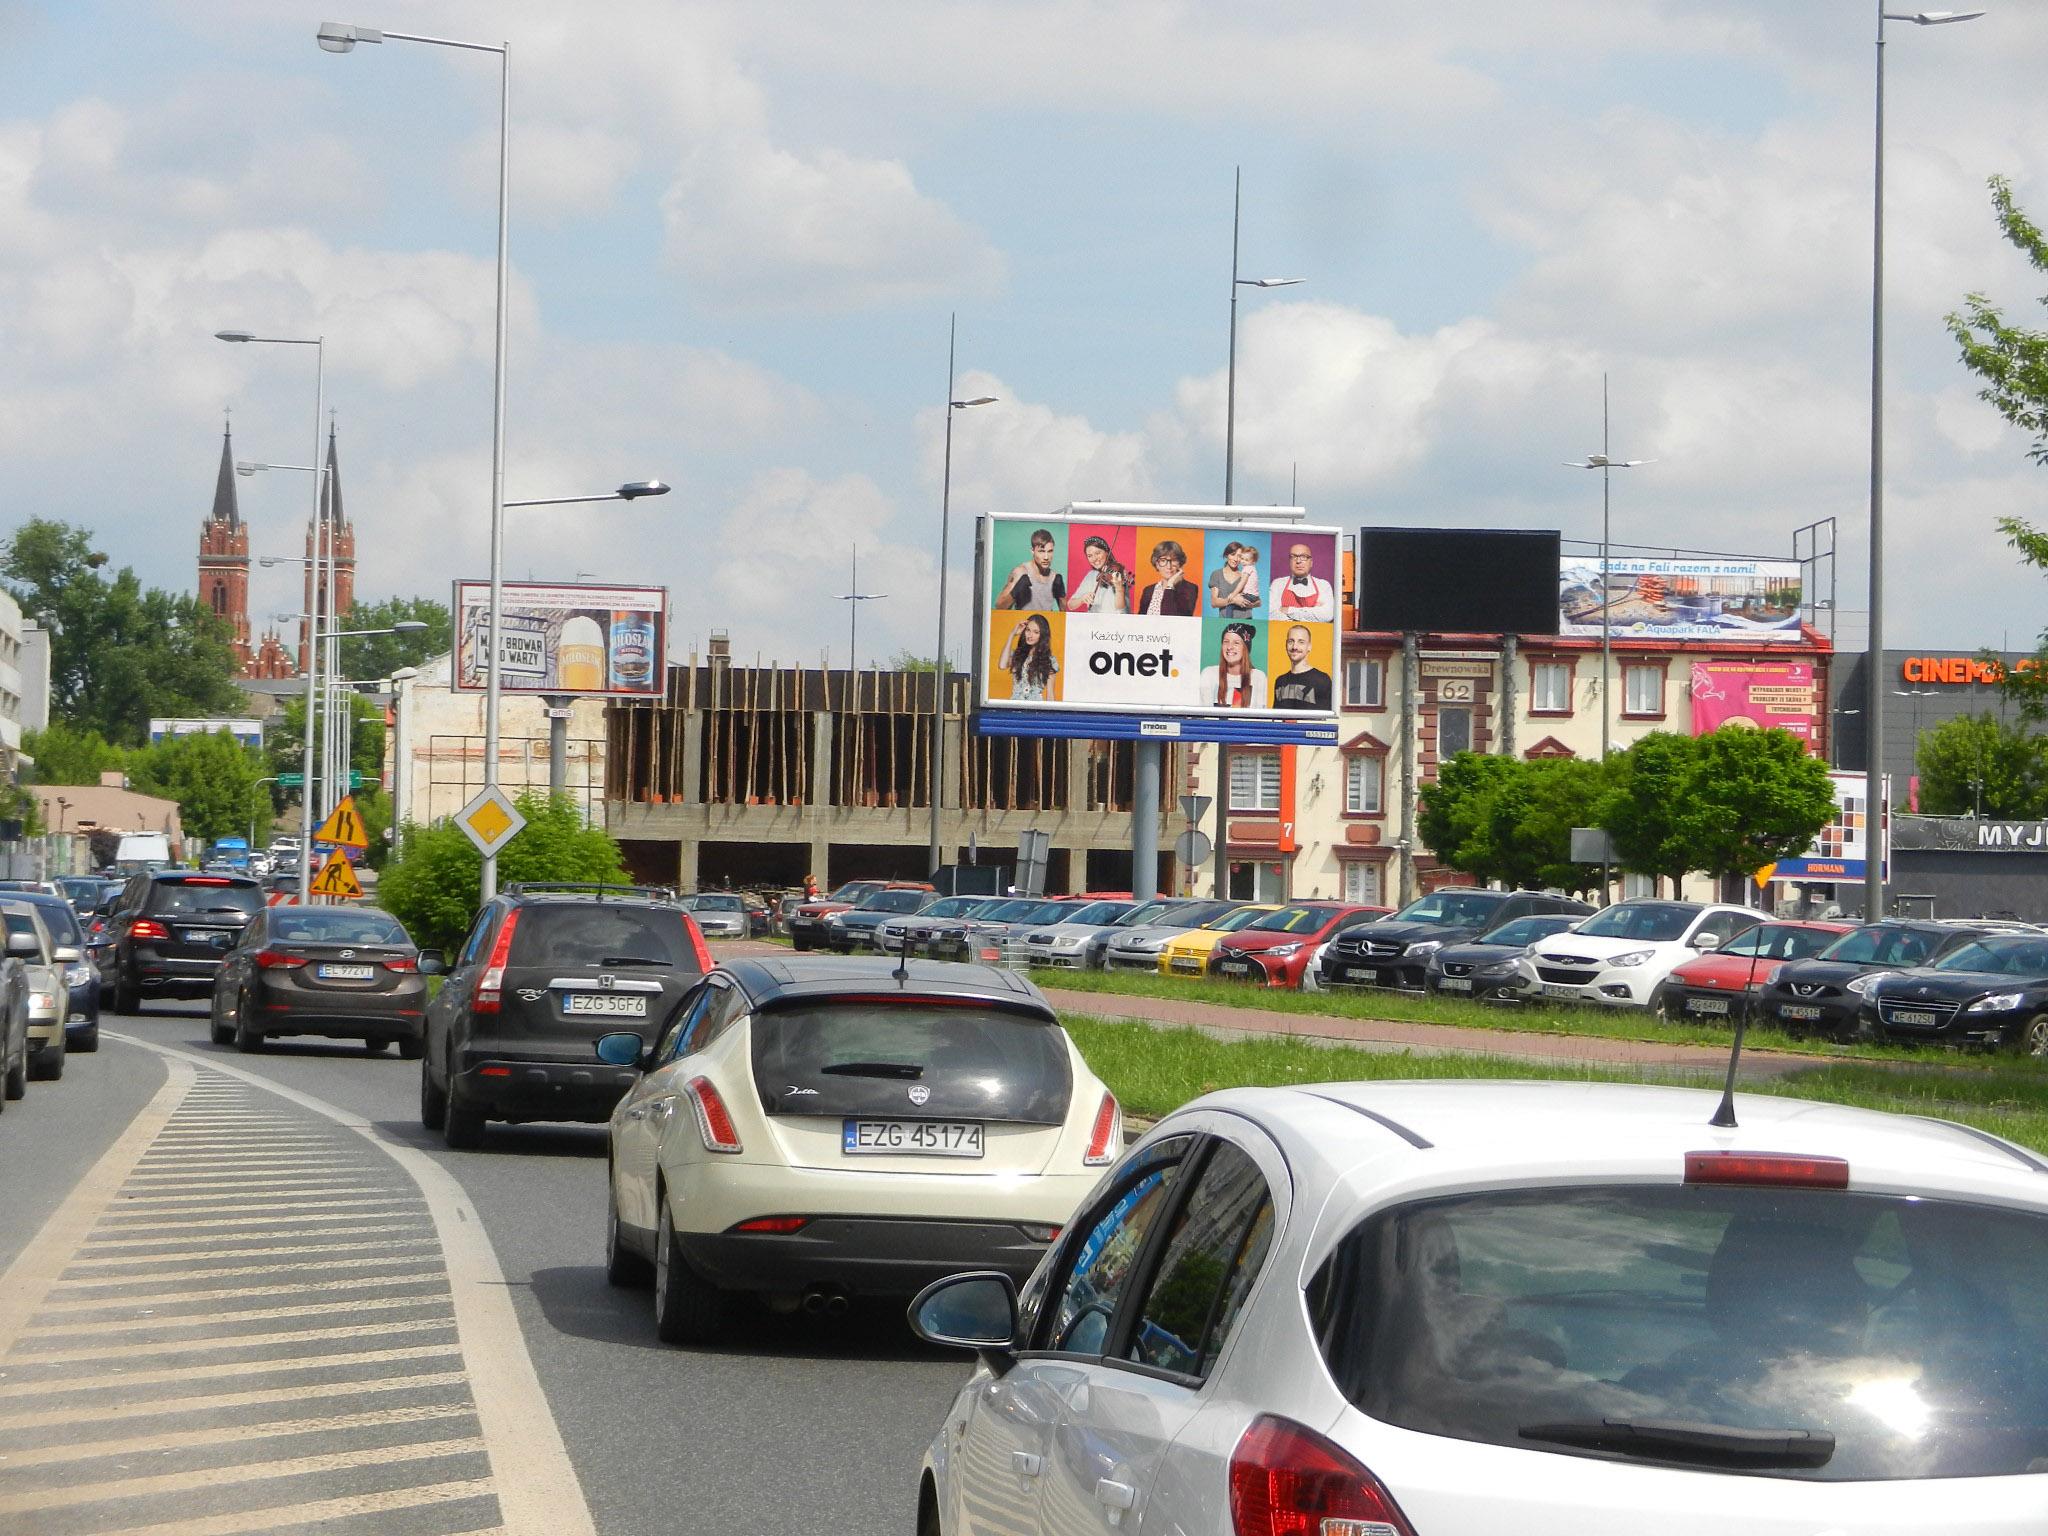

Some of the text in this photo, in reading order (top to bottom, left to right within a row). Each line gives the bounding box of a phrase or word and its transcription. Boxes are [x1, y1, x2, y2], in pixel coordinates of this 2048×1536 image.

[1649, 562, 1670, 572] Fali
[1674, 565, 1711, 573] razem
[1723, 563, 1757, 574] nami!
[1647, 623, 1721, 635] Aquapark FALA
[506, 636, 543, 653] BROWAR
[1091, 631, 1171, 645] Każdy ma swój
[509, 650, 539, 666] WARZY
[1089, 649, 1179, 677] onet.
[1423, 663, 1489, 674] Drewnowska
[1443, 680, 1470, 700] 62
[1284, 822, 1293, 838] 7
[1979, 825, 2048, 846] MYJ
[573, 995, 644, 1012] EZG 5GF6
[858, 1123, 981, 1150] EZG 45174
